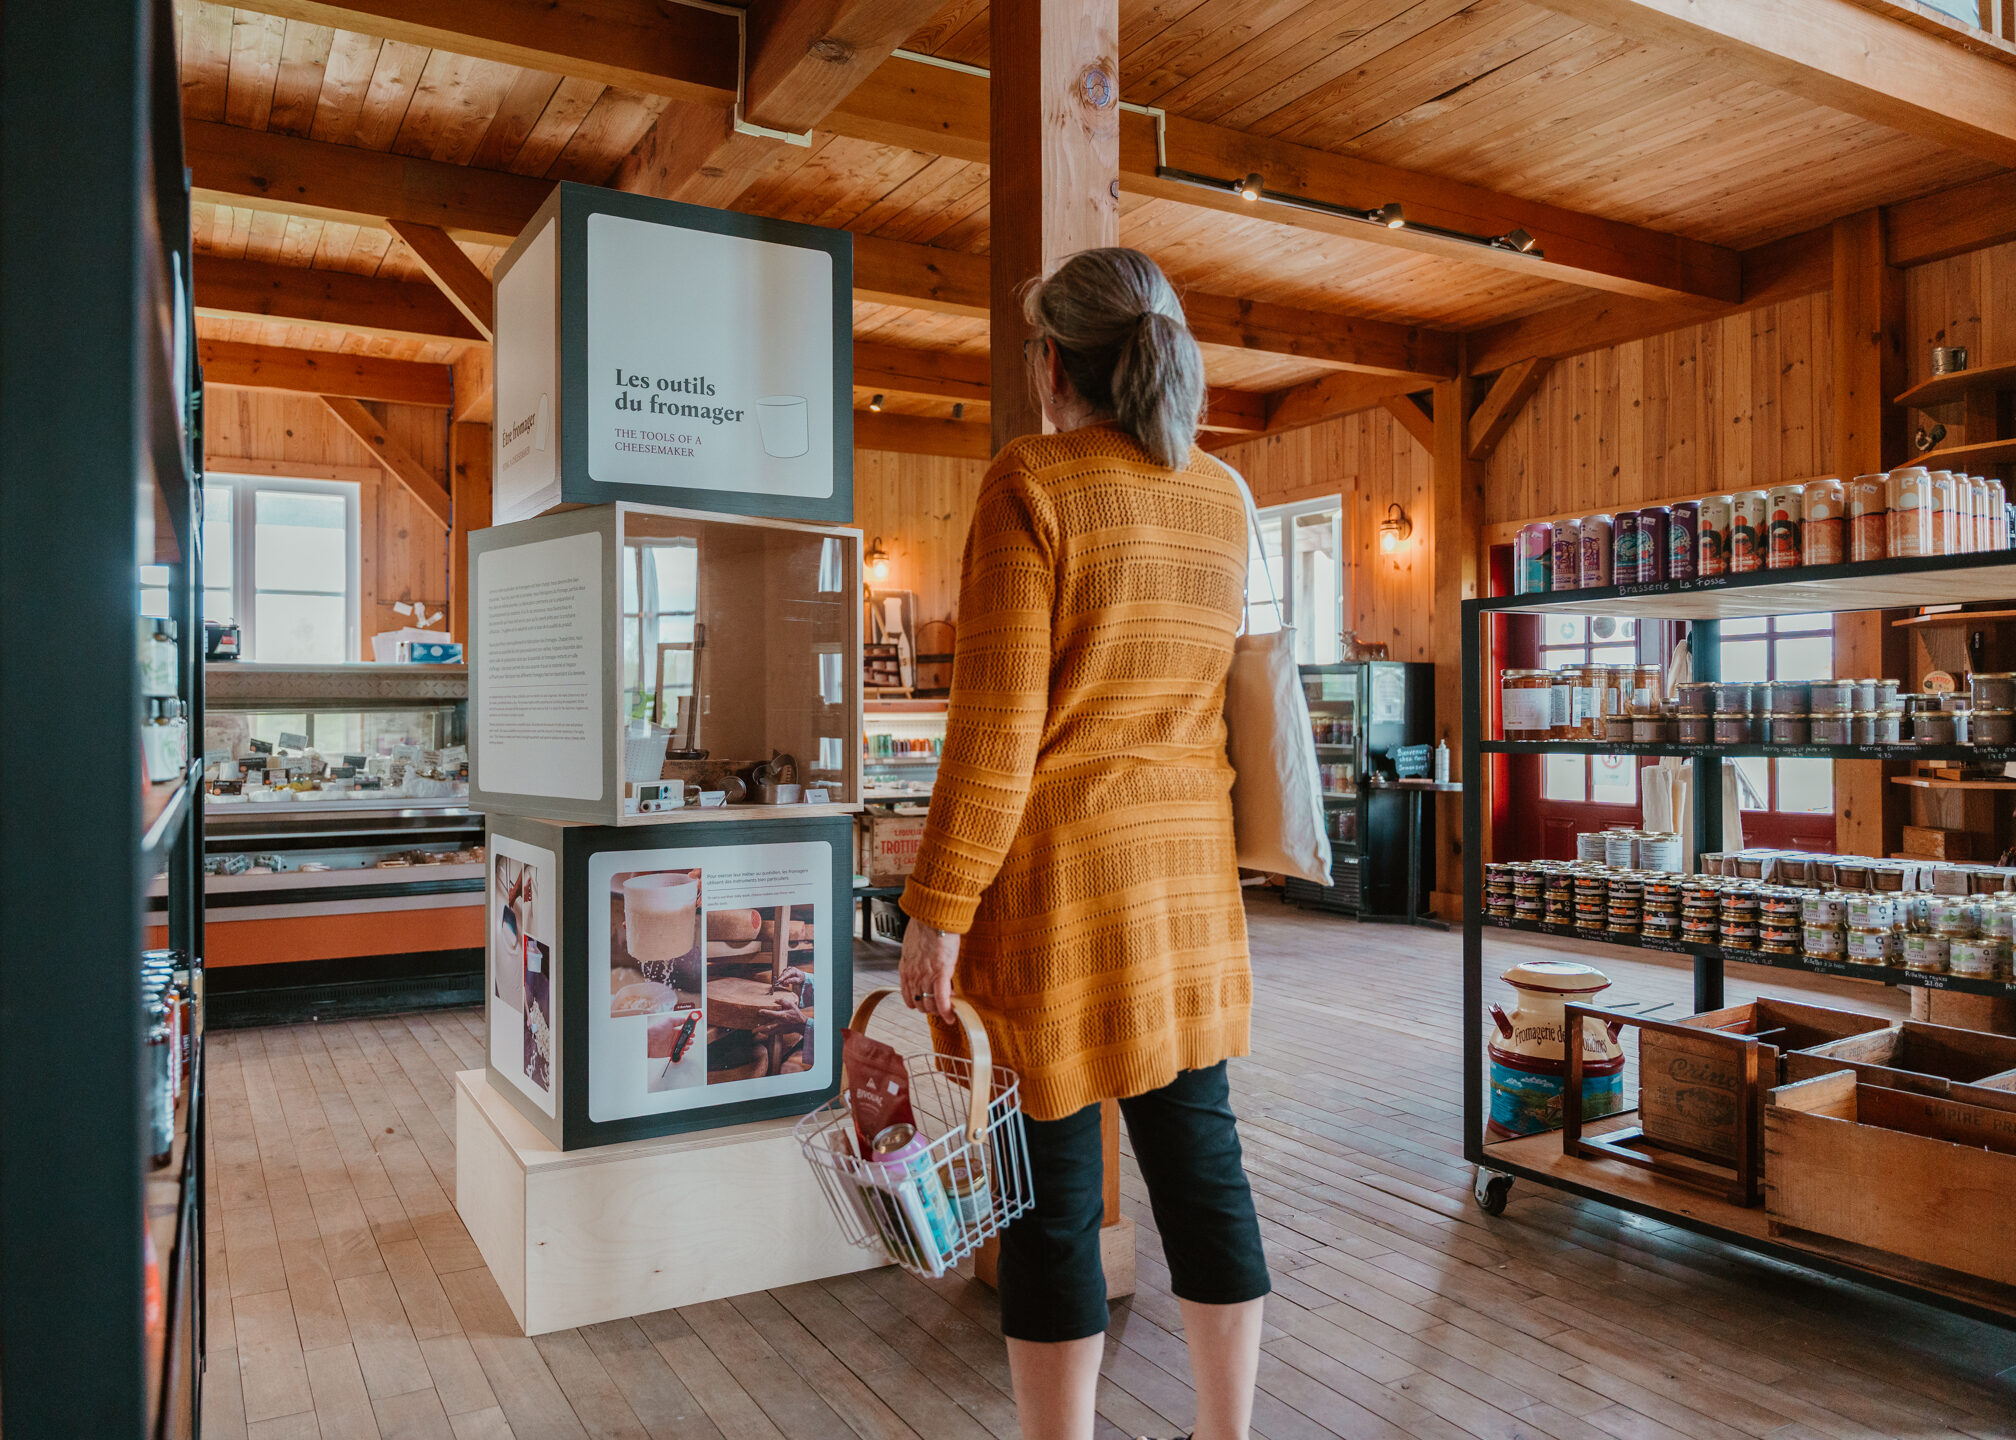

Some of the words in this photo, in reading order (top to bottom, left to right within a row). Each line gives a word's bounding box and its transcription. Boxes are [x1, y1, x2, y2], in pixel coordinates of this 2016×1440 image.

[615, 368, 650, 389] Les
[656, 376, 716, 397] outils
[614, 391, 643, 412] du
[649, 393, 745, 425] fromager
[512, 412, 536, 440] fromager
[614, 428, 637, 439] THE
[640, 430, 675, 443] TOOLS
[677, 434, 693, 444] OF
[695, 436, 702, 445] A
[614, 442, 695, 457] CHEESEMAKER
[1618, 582, 1670, 596] Brasserie
[1679, 580, 1692, 589] La
[1695, 577, 1727, 587] Fosse
[880, 840, 921, 855] TROTTIE
[1924, 979, 1944, 988] 21.00
[1923, 1103, 1983, 1127] EMPIRE
